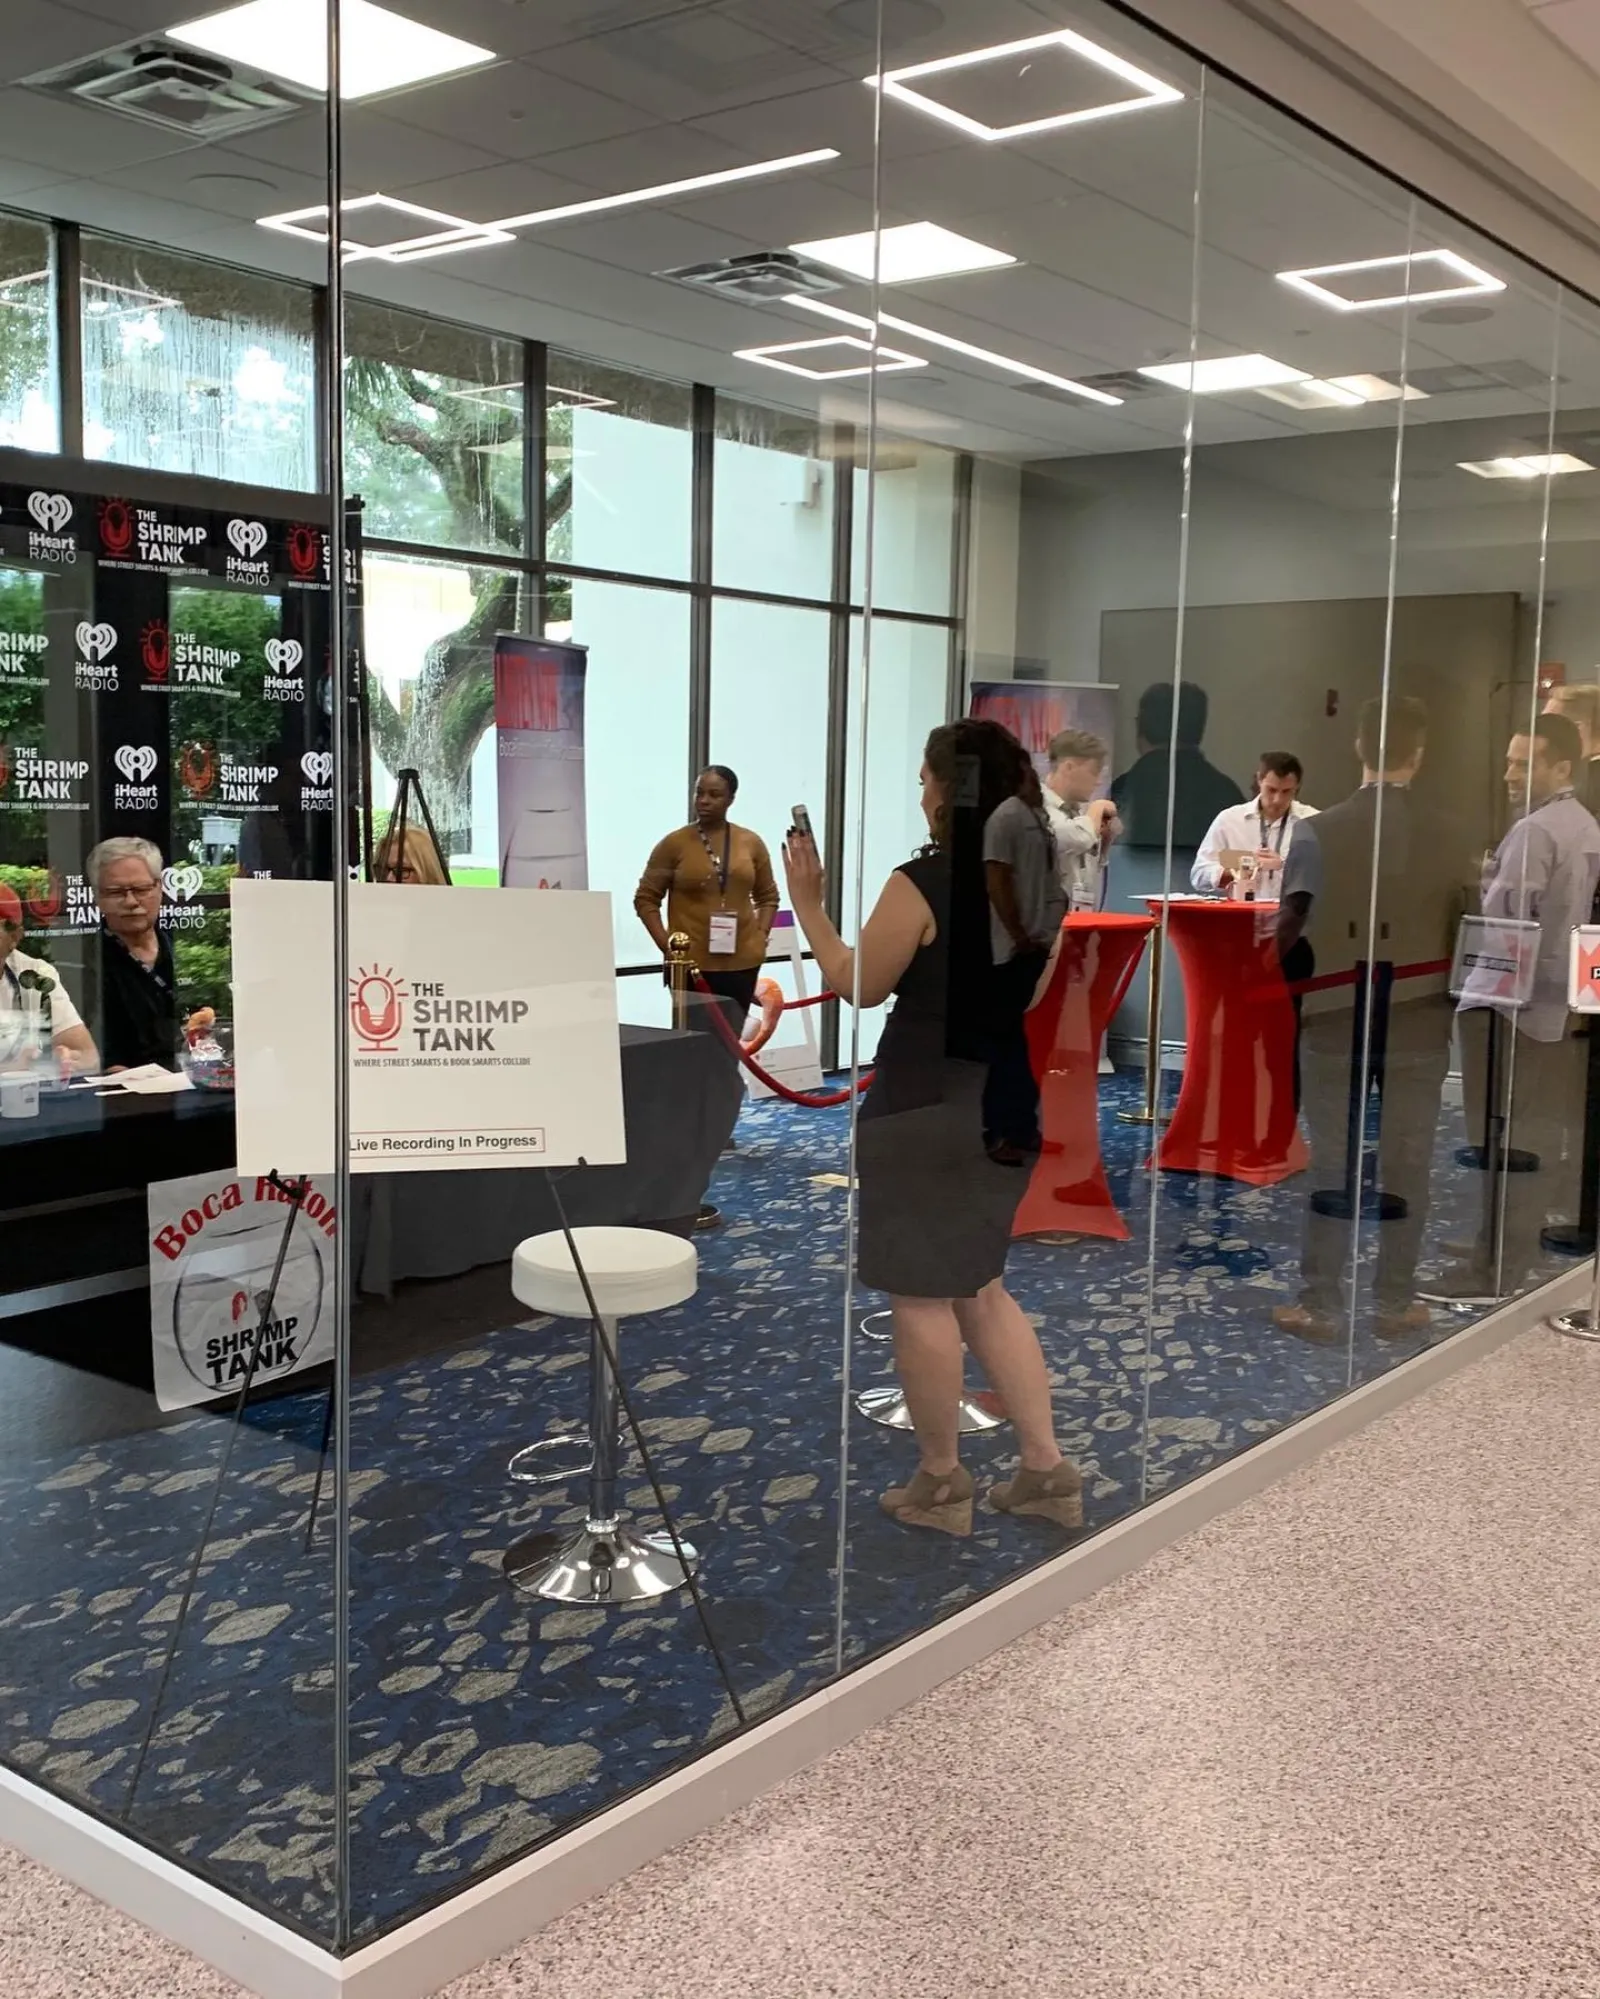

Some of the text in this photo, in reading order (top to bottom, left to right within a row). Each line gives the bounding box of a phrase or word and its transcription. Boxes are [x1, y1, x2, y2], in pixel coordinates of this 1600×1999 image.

[136, 509, 157, 522] THE
[29, 531, 75, 549] iHeart
[138, 521, 207, 545] SHRIMP
[29, 546, 77, 564] RADIO
[137, 541, 185, 564] TANK
[226, 556, 269, 574] iHeart
[226, 570, 270, 587] RADIO
[0, 631, 50, 653] RIMP
[174, 633, 196, 644] THE
[175, 645, 241, 669] SHRIMP
[75, 661, 118, 677] iHeart
[174, 664, 224, 685] TANK
[75, 676, 119, 691] RADIO
[264, 675, 304, 690] iHeart
[263, 689, 305, 702] RADIO
[14, 747, 37, 758] THE
[219, 753, 233, 764] THE
[15, 759, 89, 779] SHRIMP
[220, 765, 279, 783] SHRIMP
[15, 780, 71, 799] TANK
[115, 784, 158, 797] iHeart
[220, 784, 260, 802] TANK
[115, 798, 158, 810] RADIO
[66, 875, 83, 886] THE
[253, 870, 272, 880] THE
[66, 906, 105, 925] TAN
[159, 904, 205, 918] iHeart
[159, 917, 206, 930] RADIO
[411, 983, 444, 997] THE
[413, 999, 529, 1024] SHRIMP
[413, 1027, 496, 1051] TANK
[353, 1058, 381, 1067] WHERE
[383, 1058, 410, 1067] STREET
[411, 1058, 441, 1067] SMARTS
[443, 1058, 449, 1066] &
[450, 1057, 470, 1066] BOOK
[472, 1057, 501, 1066] SMARTS
[382, 1137, 455, 1151] Recording
[459, 1136, 471, 1147] In
[476, 1134, 537, 1149] Progress
[153, 1182, 245, 1261] Boca
[206, 1336, 300, 1384] TANK
